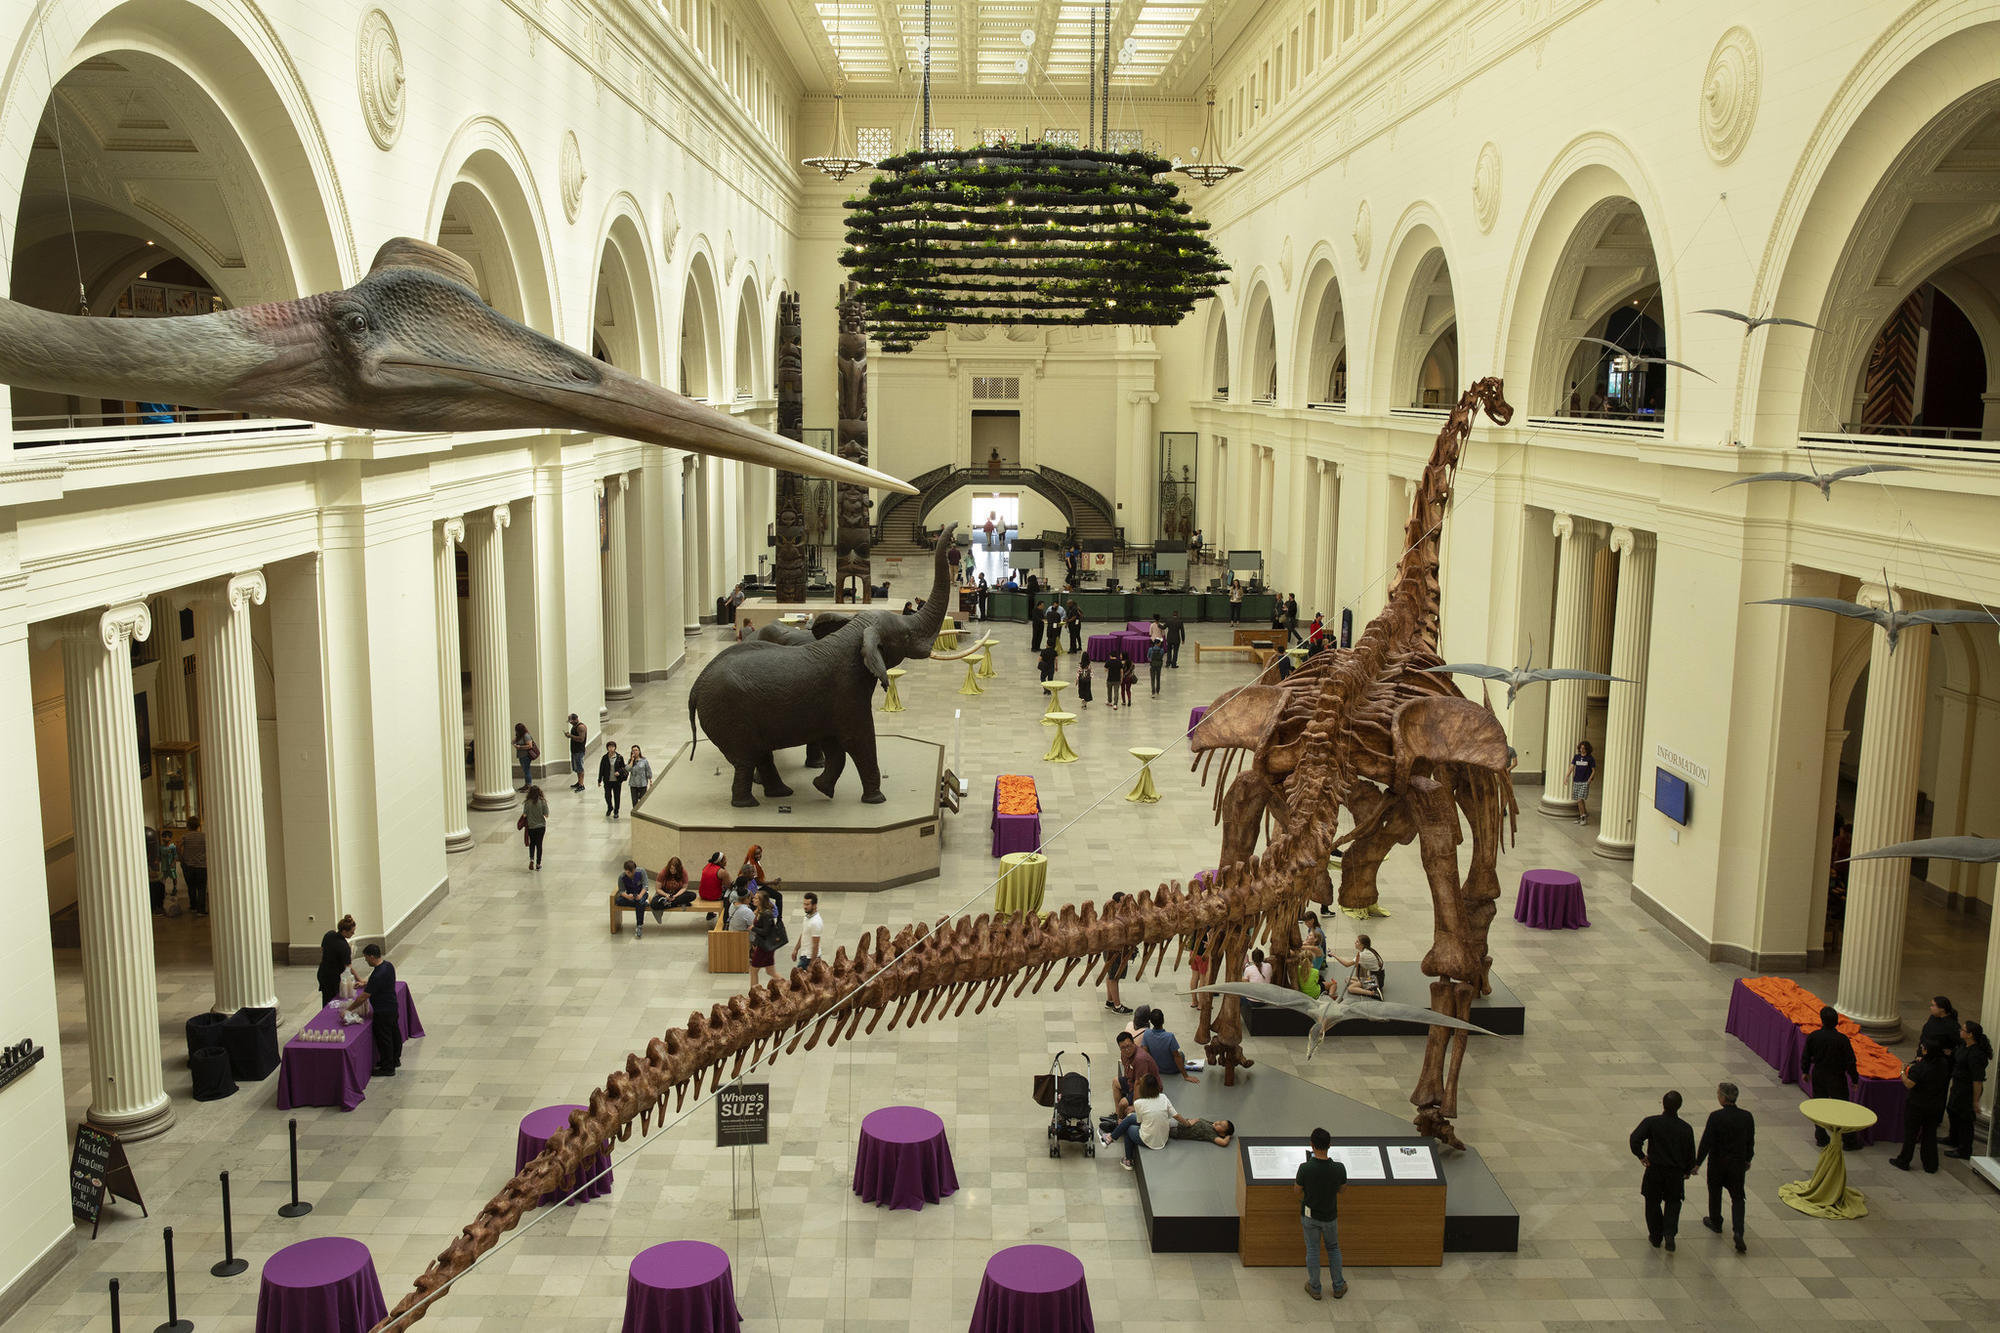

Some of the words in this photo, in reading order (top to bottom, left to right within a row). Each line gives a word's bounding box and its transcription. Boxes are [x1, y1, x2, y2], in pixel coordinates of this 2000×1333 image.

[1657, 744, 1708, 780] INFORMATION
[721, 1092, 764, 1103] Where's
[721, 1102, 765, 1117] SUE?
